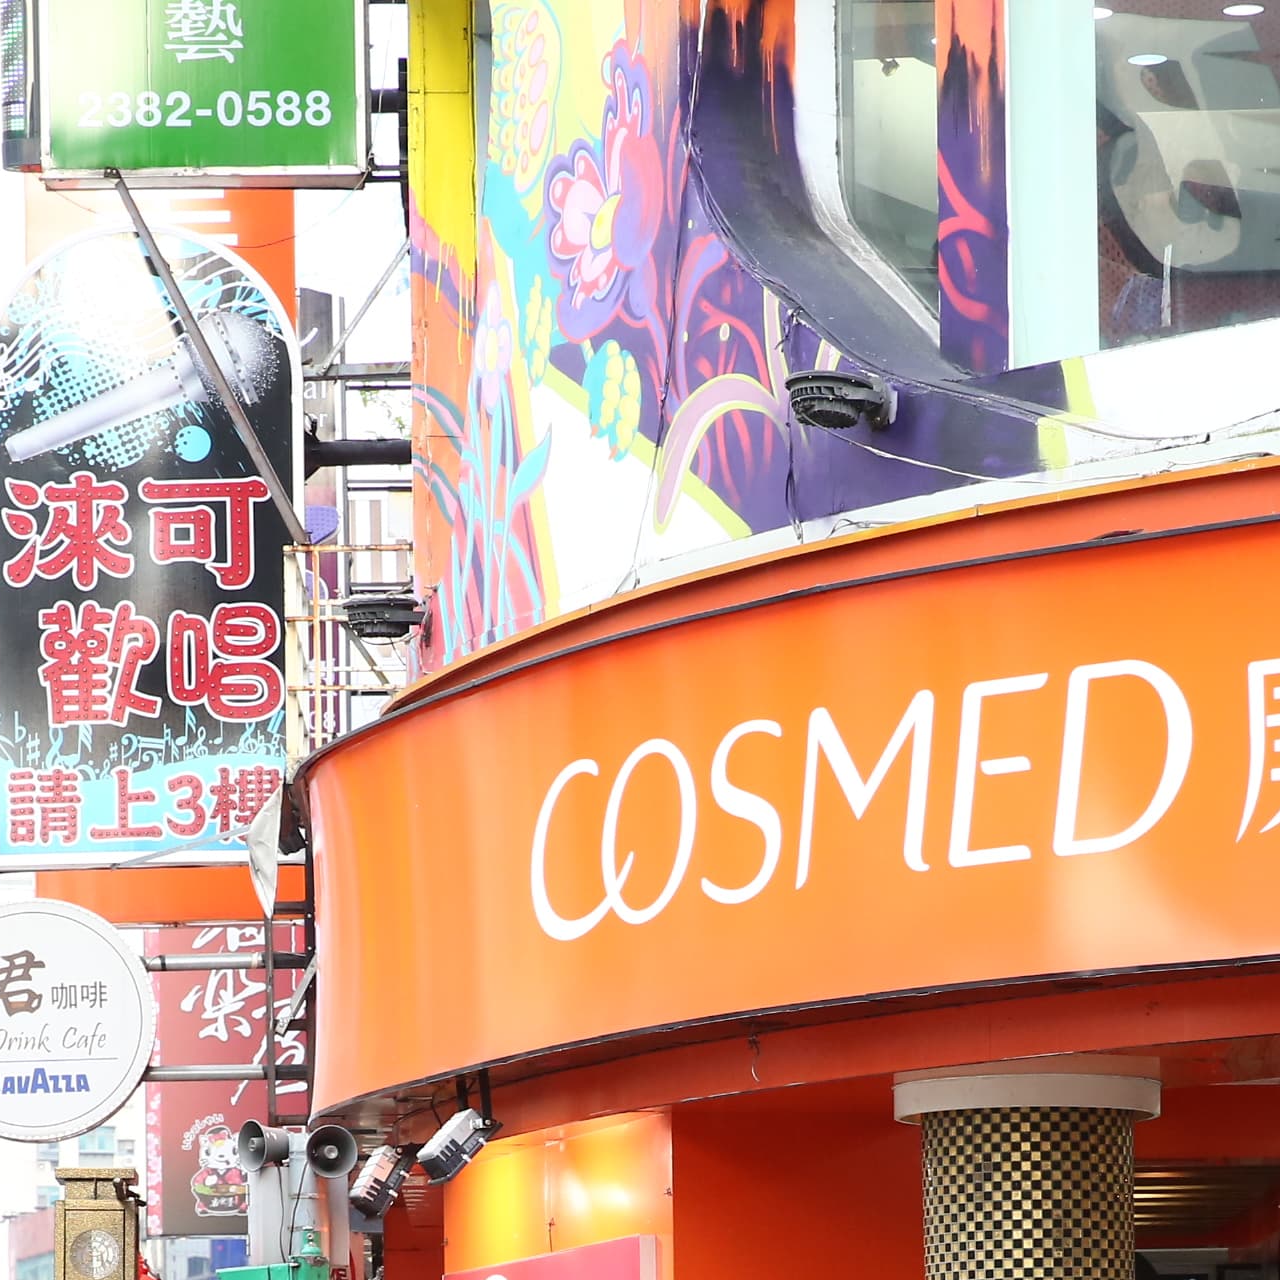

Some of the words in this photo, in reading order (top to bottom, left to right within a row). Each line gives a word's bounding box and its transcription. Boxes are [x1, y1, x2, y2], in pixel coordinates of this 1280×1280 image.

[78, 90, 332, 128] 2382-0588
[2, 471, 272, 591] 淶可
[39, 600, 285, 728] 歡唱
[8, 765, 282, 845] 請上3樓
[528, 657, 1196, 942] COSMED
[62, 1021, 107, 1056] Cafe
